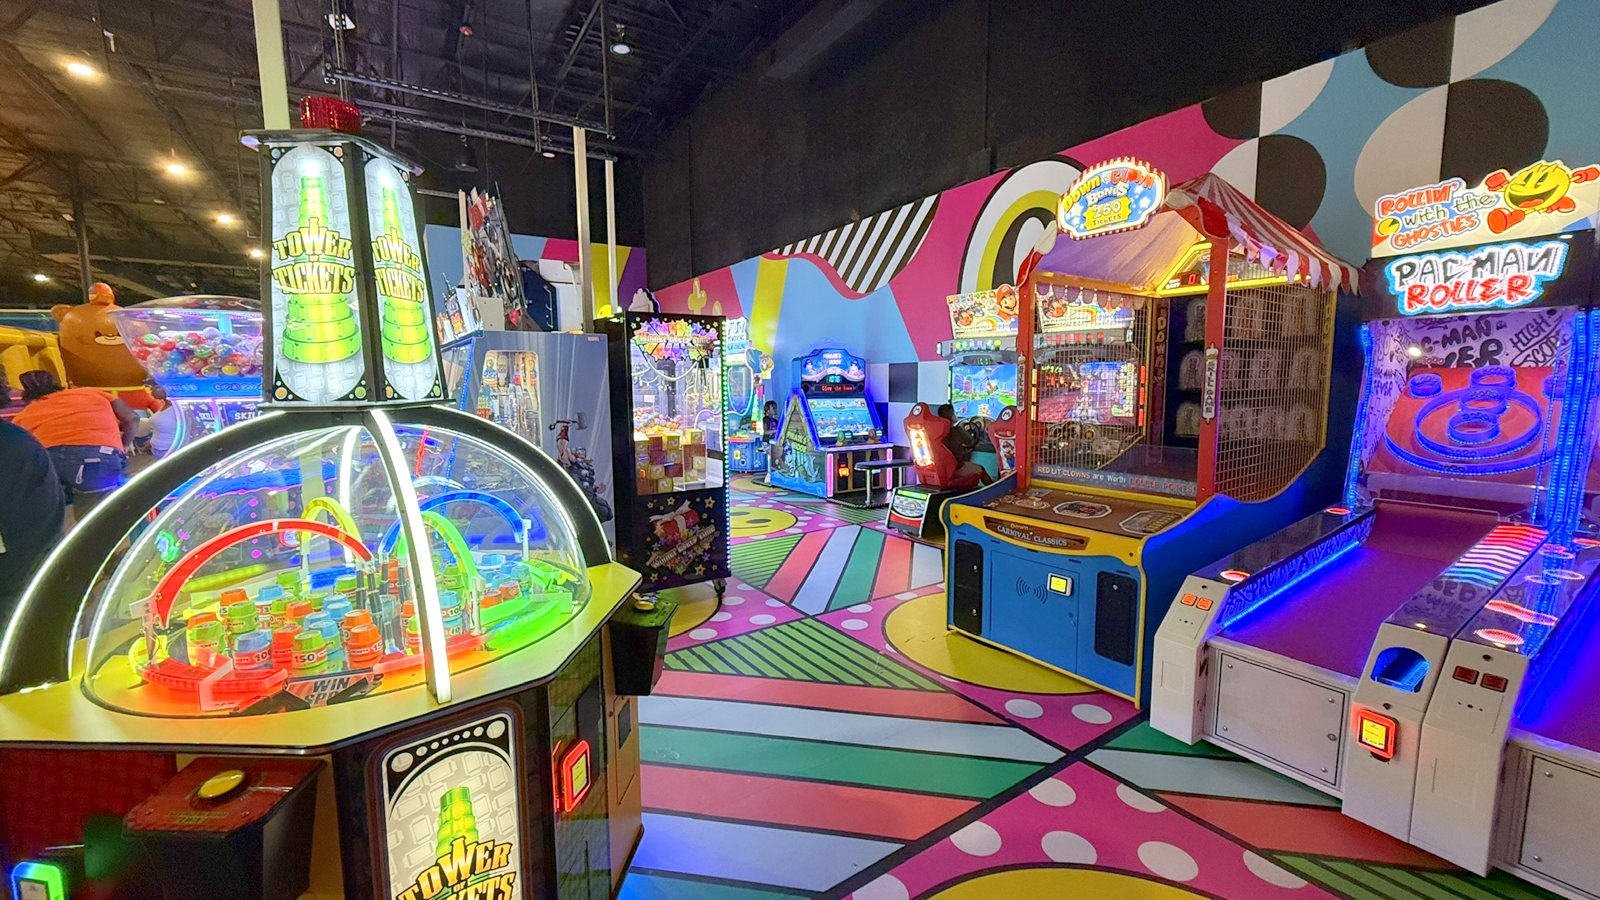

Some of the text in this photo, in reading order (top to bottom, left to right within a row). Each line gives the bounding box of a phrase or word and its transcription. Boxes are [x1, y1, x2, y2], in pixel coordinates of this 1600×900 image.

[1086, 182, 1129, 206] BONUS
[1111, 168, 1155, 189] CLOWN
[1093, 200, 1121, 218] 250
[1404, 192, 1497, 227] with the
[272, 217, 353, 260] TOWER
[1393, 213, 1478, 247] GHOSTIES
[371, 227, 421, 273] TOWER
[272, 262, 355, 294] TICKETS
[374, 268, 425, 303] TICKETS
[1406, 274, 1533, 310] ROLLER
[1509, 312, 1552, 353] HIGH
[1037, 465, 1050, 475] RED
[1051, 467, 1061, 475] LIT
[1062, 469, 1091, 479] CLOWNS
[1092, 473, 1104, 481] are
[1107, 475, 1126, 484] Worth
[996, 525, 1068, 547] CARNIVAL CLASSICS
[294, 654, 315, 663] 150
[311, 677, 350, 695] WIN
[396, 835, 513, 900] TOWER
